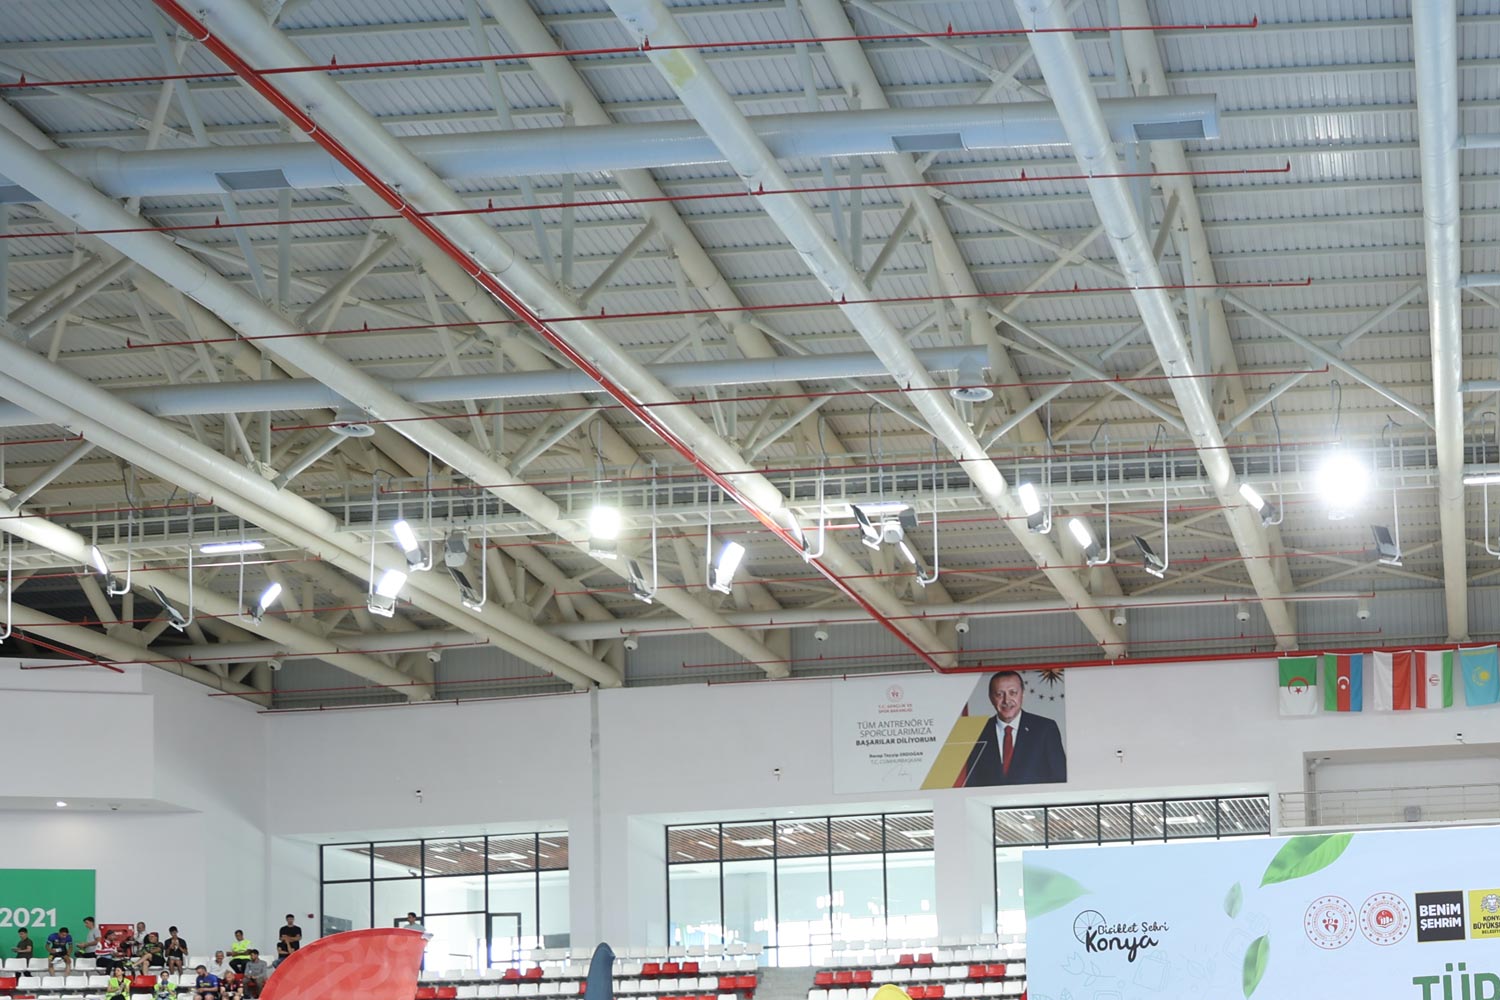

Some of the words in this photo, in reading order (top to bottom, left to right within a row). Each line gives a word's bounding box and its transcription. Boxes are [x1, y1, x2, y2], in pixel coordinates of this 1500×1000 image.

[857, 721, 876, 729] TÜM
[878, 719, 922, 728] ANTRENÖR
[923, 719, 934, 727] VE
[855, 738, 895, 747] BAŞARILAR
[0, 908, 57, 928] 2021
[1086, 930, 1159, 963] Konya
